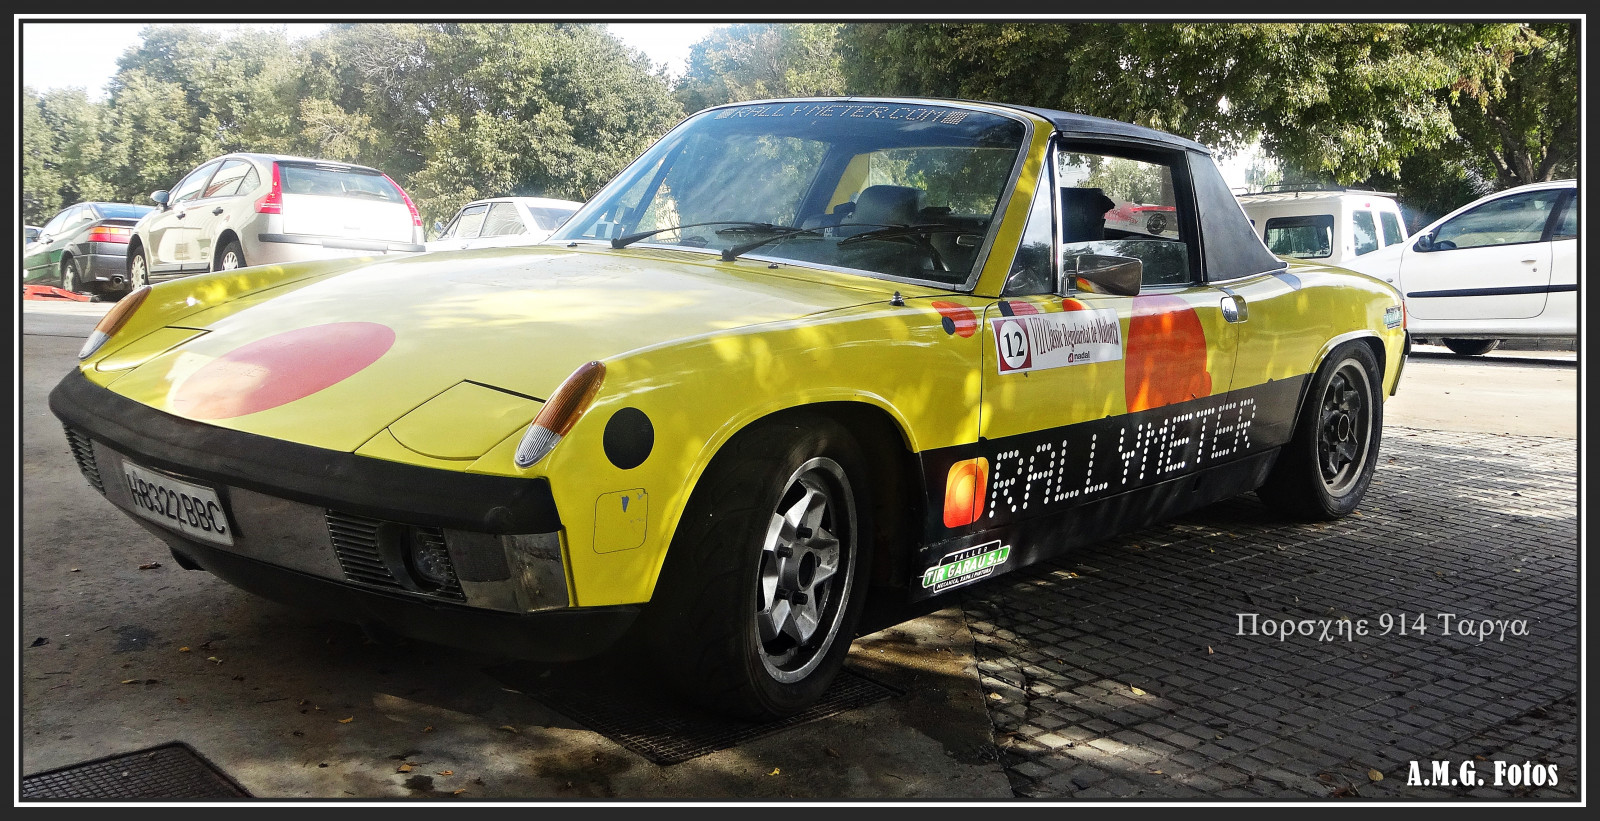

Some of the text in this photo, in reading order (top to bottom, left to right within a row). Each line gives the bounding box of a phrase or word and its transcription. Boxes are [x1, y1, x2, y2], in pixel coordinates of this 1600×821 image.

[730, 104, 944, 124] RALLYMETER.COM
[1004, 331, 1025, 358] 12
[1074, 350, 1091, 360] nadal
[988, 398, 1257, 518] RALLYMETER
[126, 470, 226, 534] H8322BBC
[954, 546, 988, 562] TALLER
[926, 567, 945, 585] TIR
[947, 557, 986, 578] GARAU
